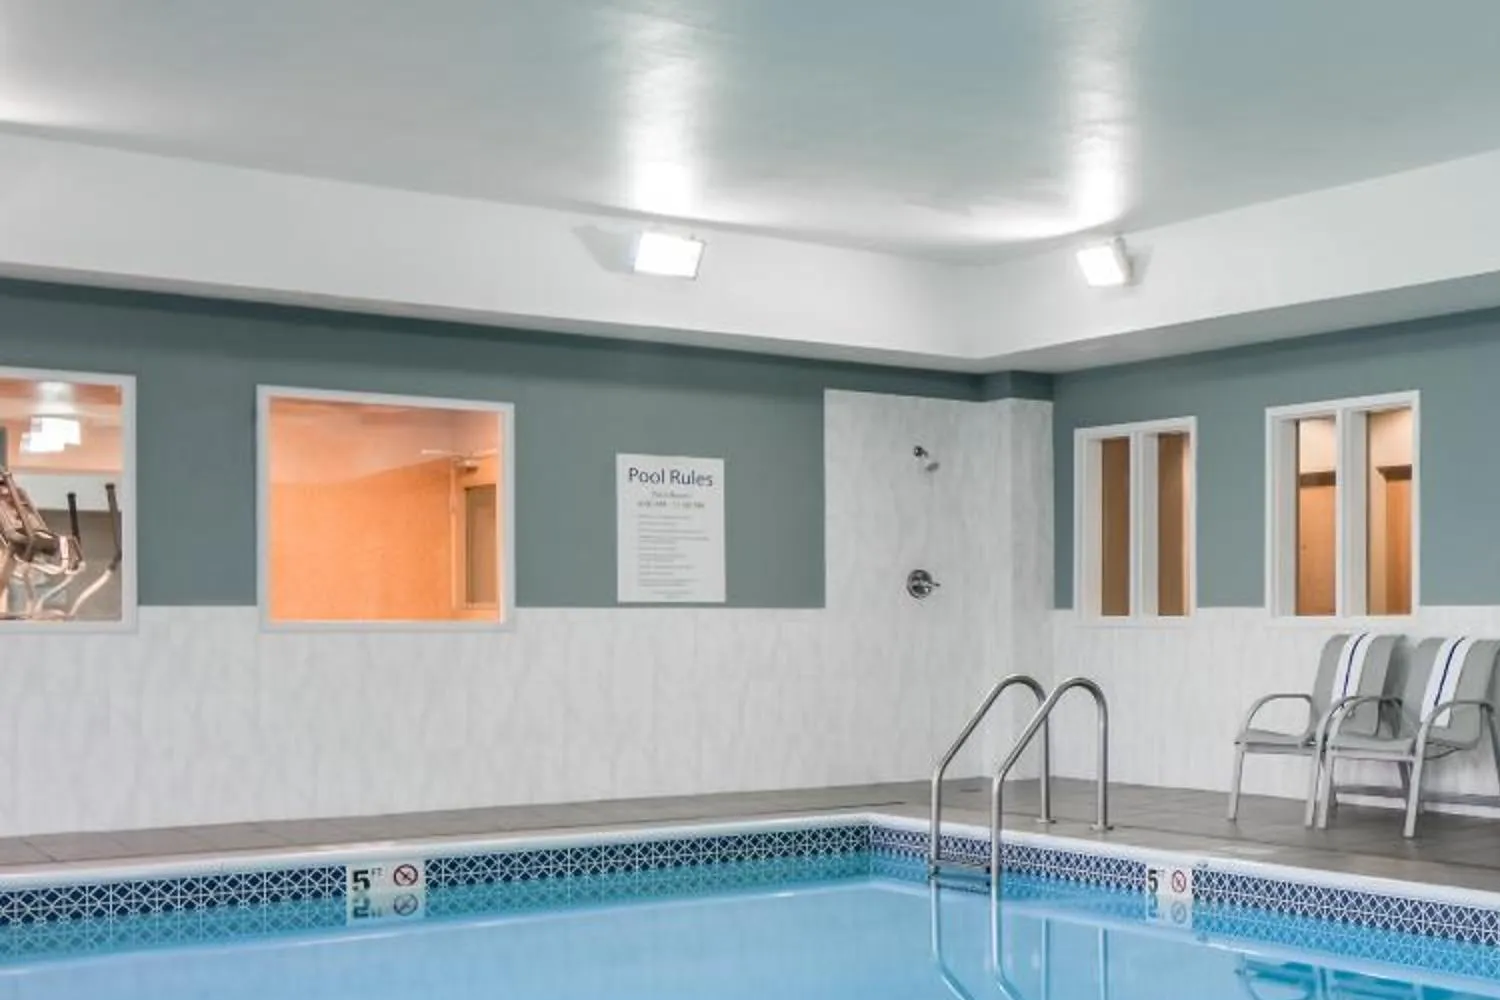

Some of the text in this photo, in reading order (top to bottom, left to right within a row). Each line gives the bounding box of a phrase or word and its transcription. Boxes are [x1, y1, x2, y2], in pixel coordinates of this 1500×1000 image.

[628, 467, 713, 487] Pool Rules
[352, 869, 371, 891] 5
[1148, 869, 1158, 893] 5
